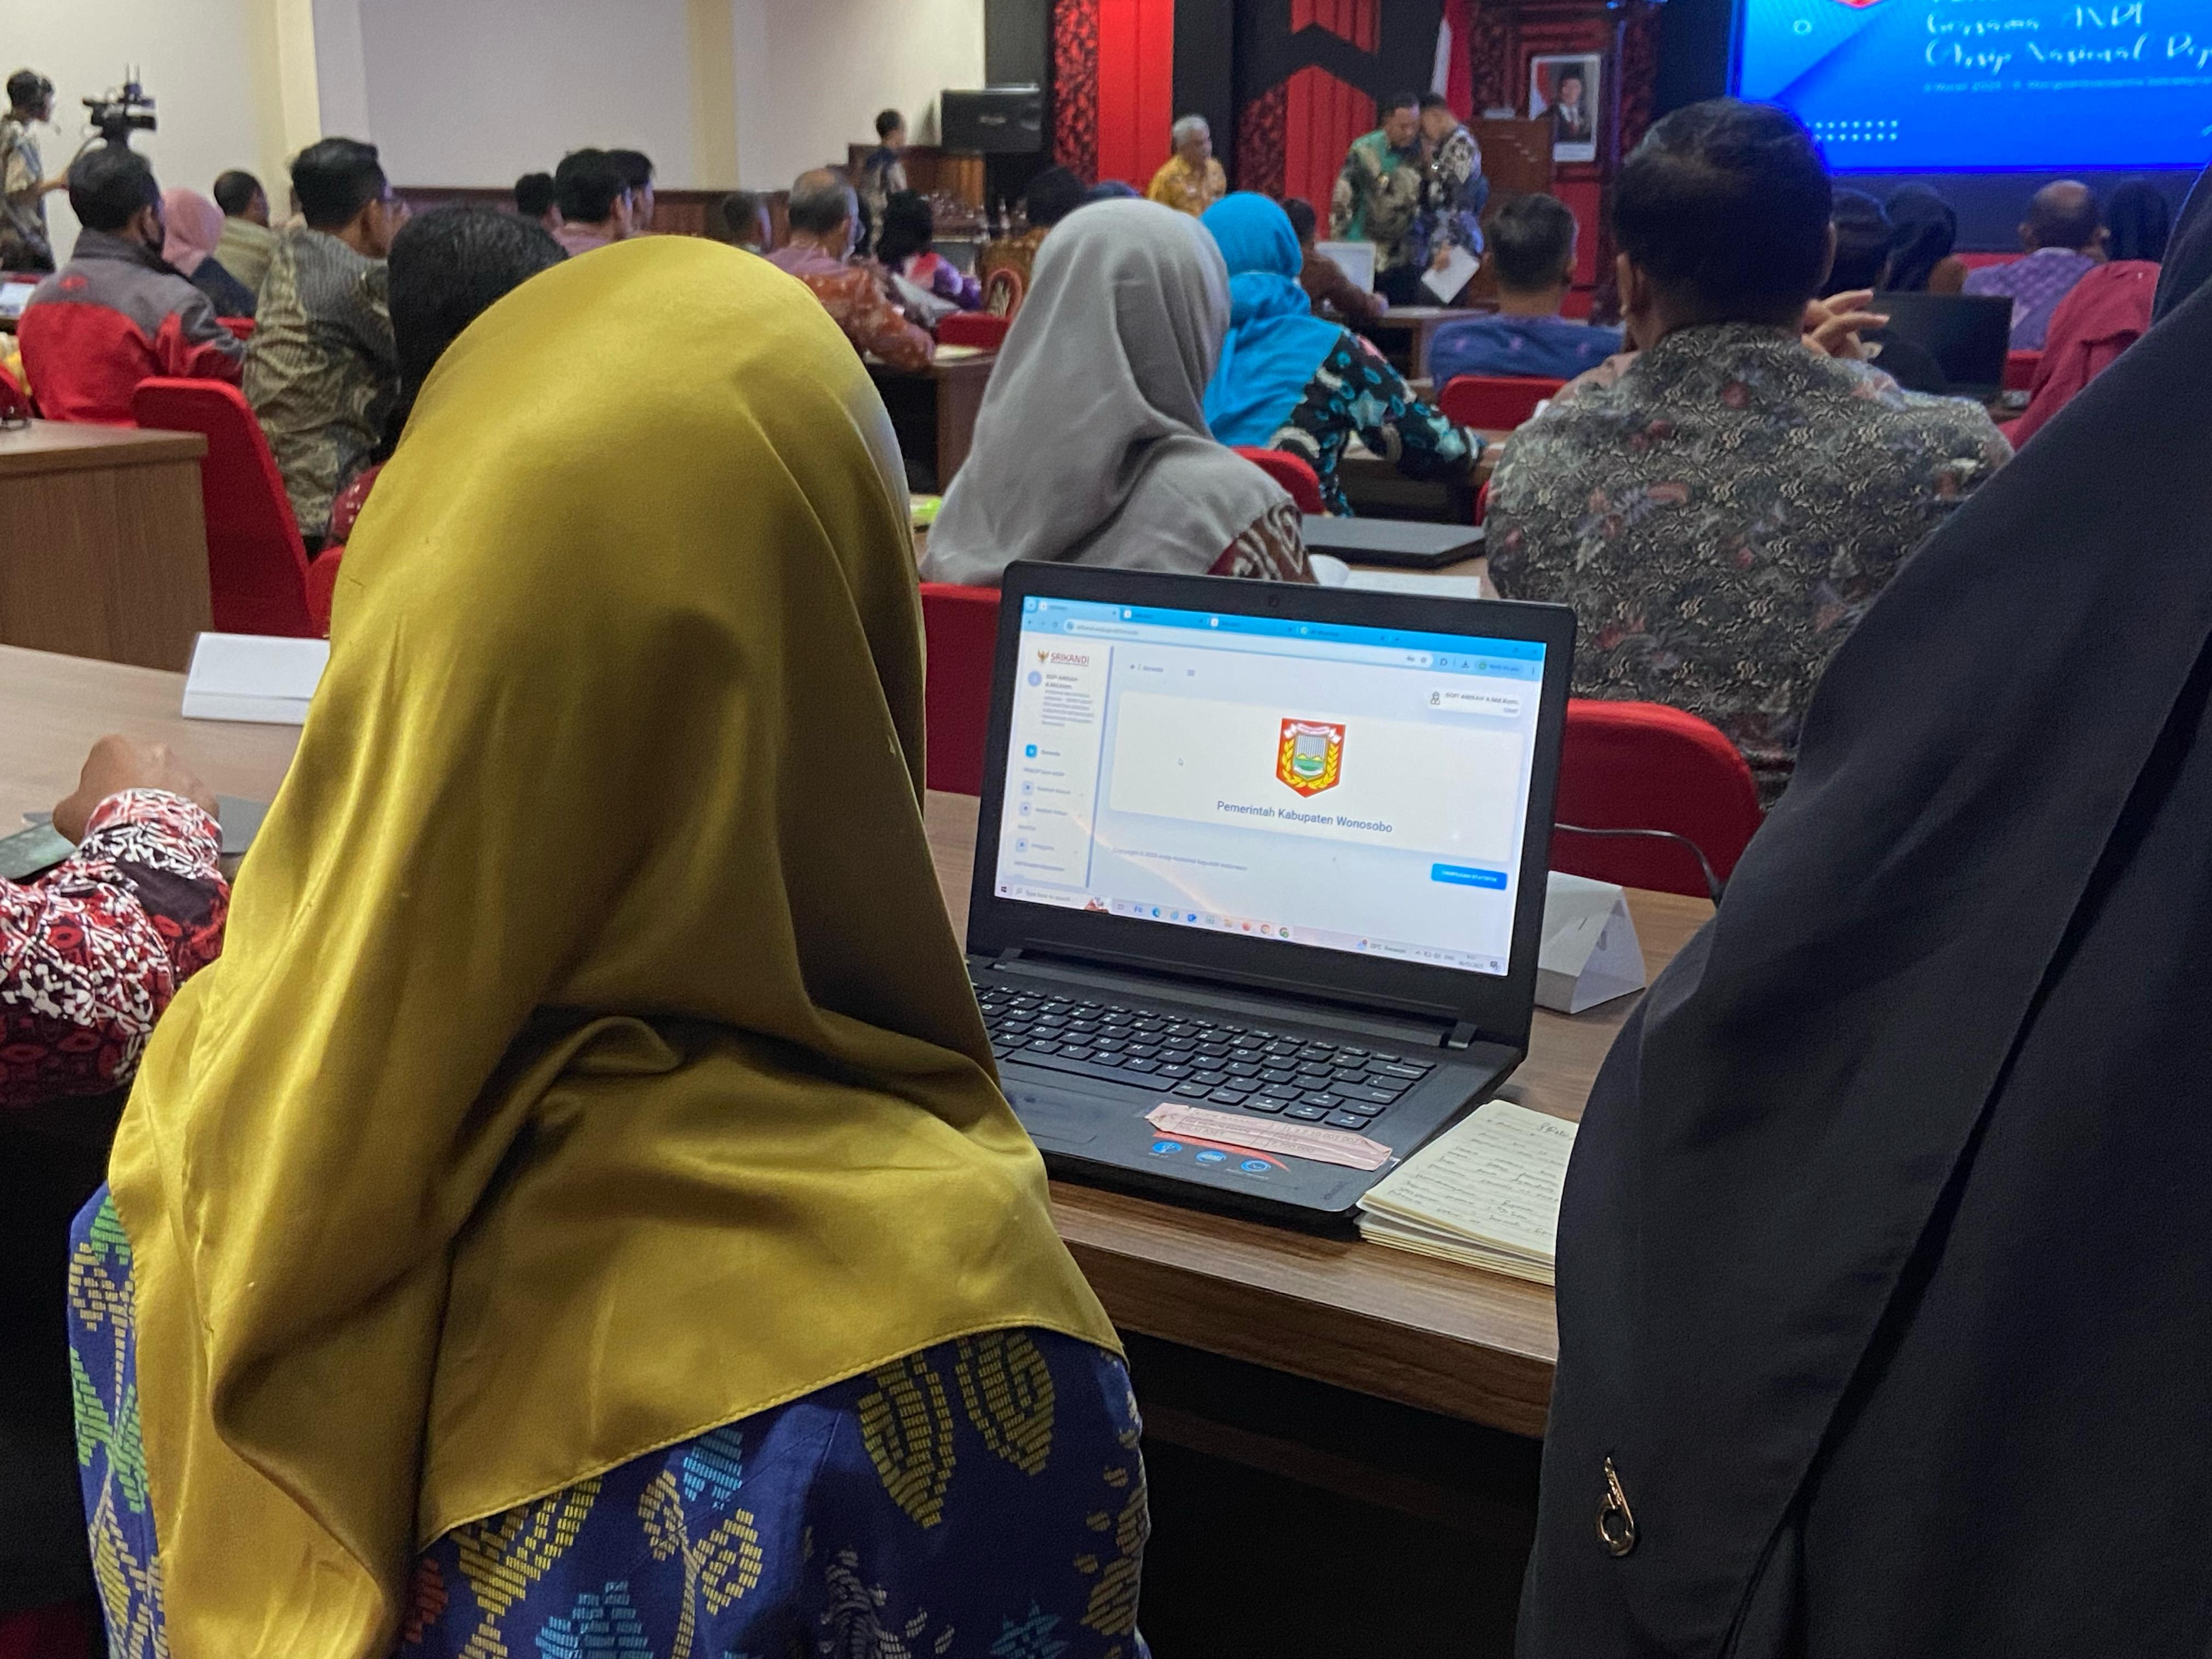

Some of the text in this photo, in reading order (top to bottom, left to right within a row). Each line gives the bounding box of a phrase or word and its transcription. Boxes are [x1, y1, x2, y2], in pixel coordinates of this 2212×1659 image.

[1051, 652, 1090, 664] SRIKANDI
[1217, 800, 1392, 833] Pemerintah Kabupaten Wonosobo
